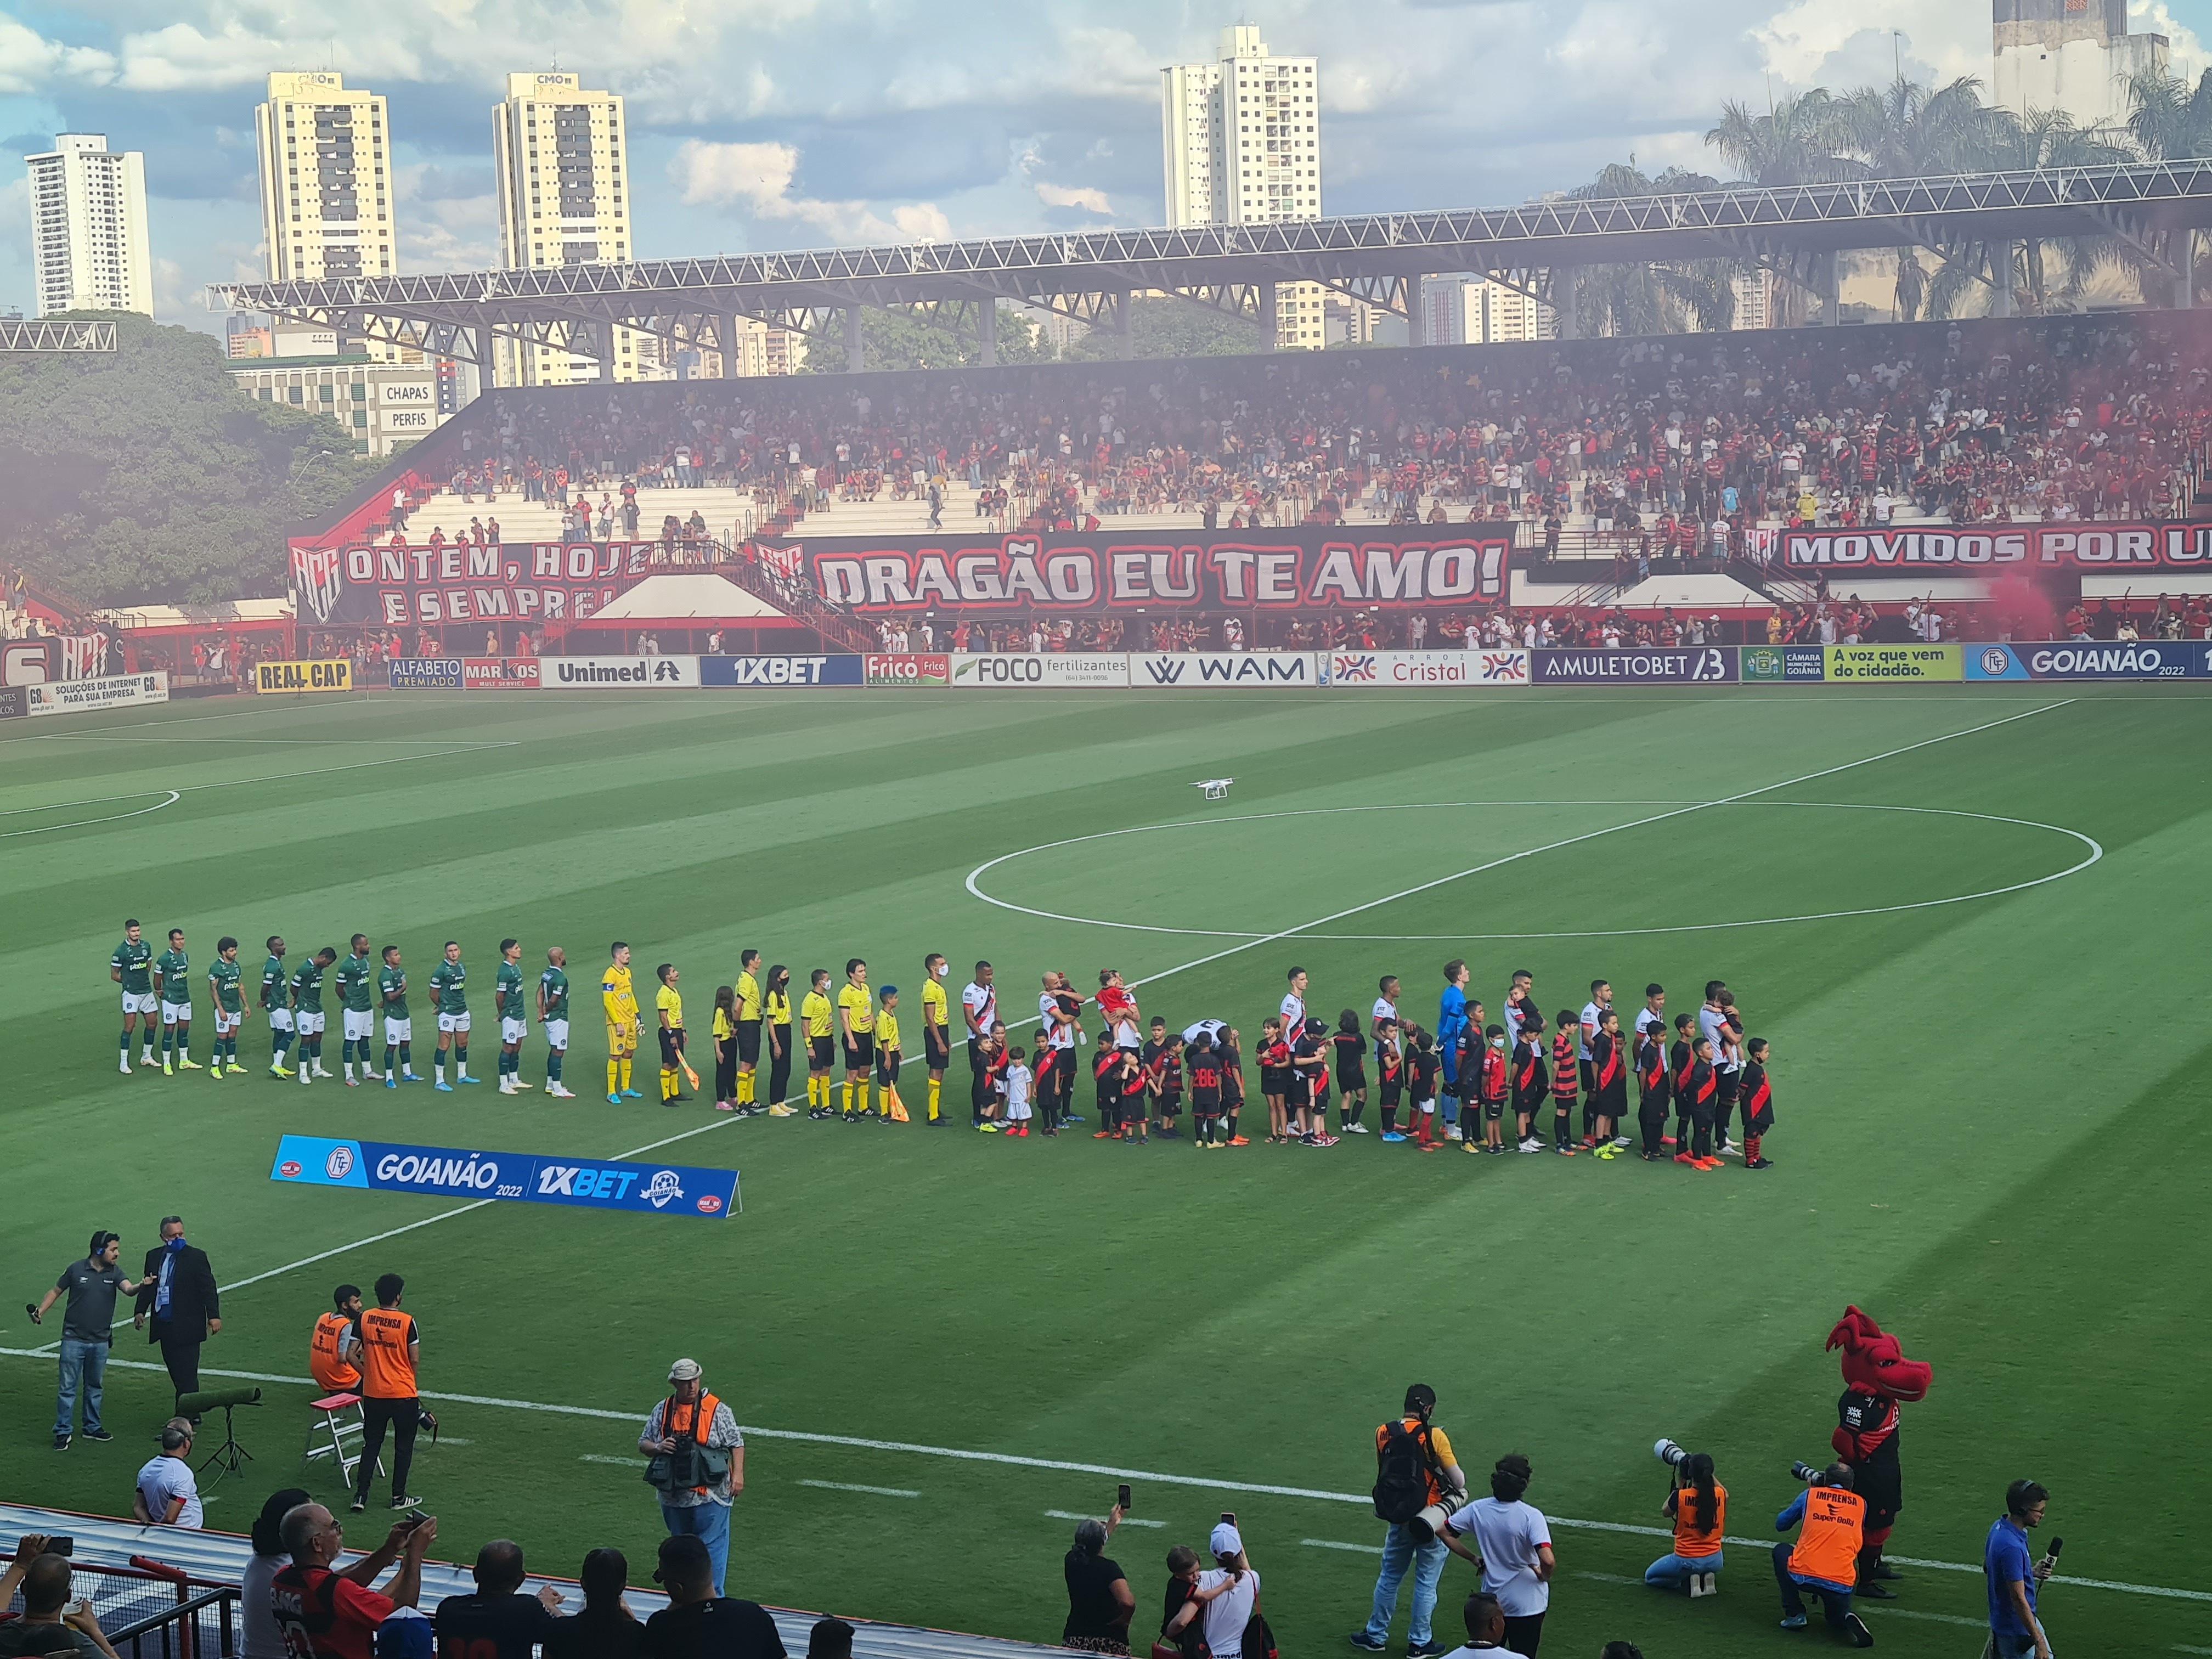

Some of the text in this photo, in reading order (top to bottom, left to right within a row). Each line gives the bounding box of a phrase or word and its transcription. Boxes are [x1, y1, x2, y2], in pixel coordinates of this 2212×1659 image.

[537, 75, 563, 84] CMO
[387, 387, 428, 400] CHAPAS
[393, 413, 426, 426] PERFIS
[1790, 529, 2212, 563] MOVIDOS POR U
[349, 544, 651, 580] ONTEM, HOJE
[819, 541, 1503, 603] DRAGÃO EU TE AMO!
[384, 592, 408, 622] E
[1787, 652, 1820, 661] CÂMARA
[1834, 648, 1944, 664] A voz que vem
[2032, 642, 2185, 675] GOIANÃO 2022
[392, 660, 460, 675] ALFABETO
[558, 661, 646, 682] Unimed
[734, 657, 827, 684] 1XBET
[868, 654, 918, 678] Fricó
[923, 660, 945, 670] Fricó
[978, 658, 1042, 681] FOCO
[1047, 659, 1126, 670] fertilizantes
[1199, 658, 1305, 680] WAM
[1393, 662, 1465, 680] Cristal
[1545, 656, 1688, 675] AMULETOBET
[1786, 666, 1821, 675] GOIÂNIA
[1834, 663, 1925, 677] do cidadão.
[144, 676, 155, 692] G8
[261, 664, 346, 689] REAL CAP
[397, 676, 456, 686] PREMIADO
[56, 678, 140, 695] SOLUÇÕES DE INTERNET
[30, 688, 42, 704] G8
[64, 689, 135, 703] PARA SUA EMPRESA
[1193, 1068, 1217, 1087] 286
[377, 1153, 523, 1197] GOIANÃO 2022
[538, 1166, 639, 1200] 1XBET
[367, 1314, 401, 1329] IMPRENSA
[1816, 1491, 1857, 1506] IMPRENSA
[1813, 1513, 1836, 1522] Super
